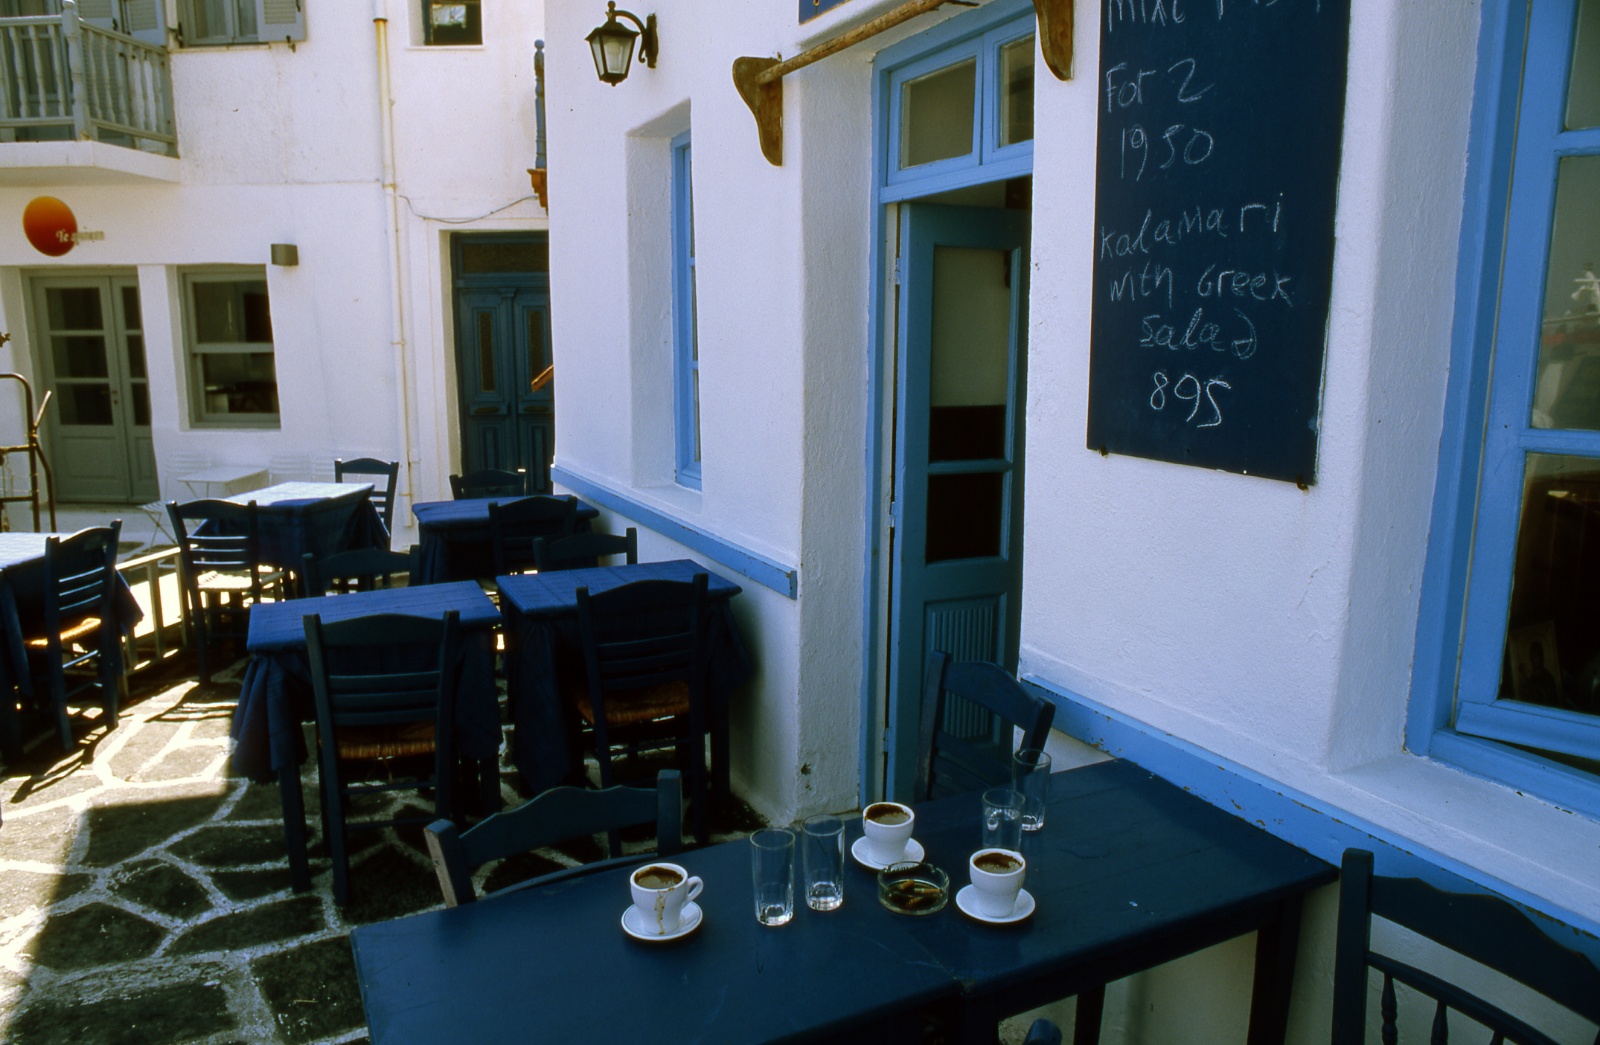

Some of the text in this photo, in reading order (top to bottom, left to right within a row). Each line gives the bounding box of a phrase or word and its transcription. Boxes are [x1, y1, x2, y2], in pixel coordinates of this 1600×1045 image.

[1106, 57, 1216, 113] For 2
[1120, 123, 1214, 181] 1950
[1197, 263, 1295, 307] Greek
[1150, 371, 1232, 428] 895
